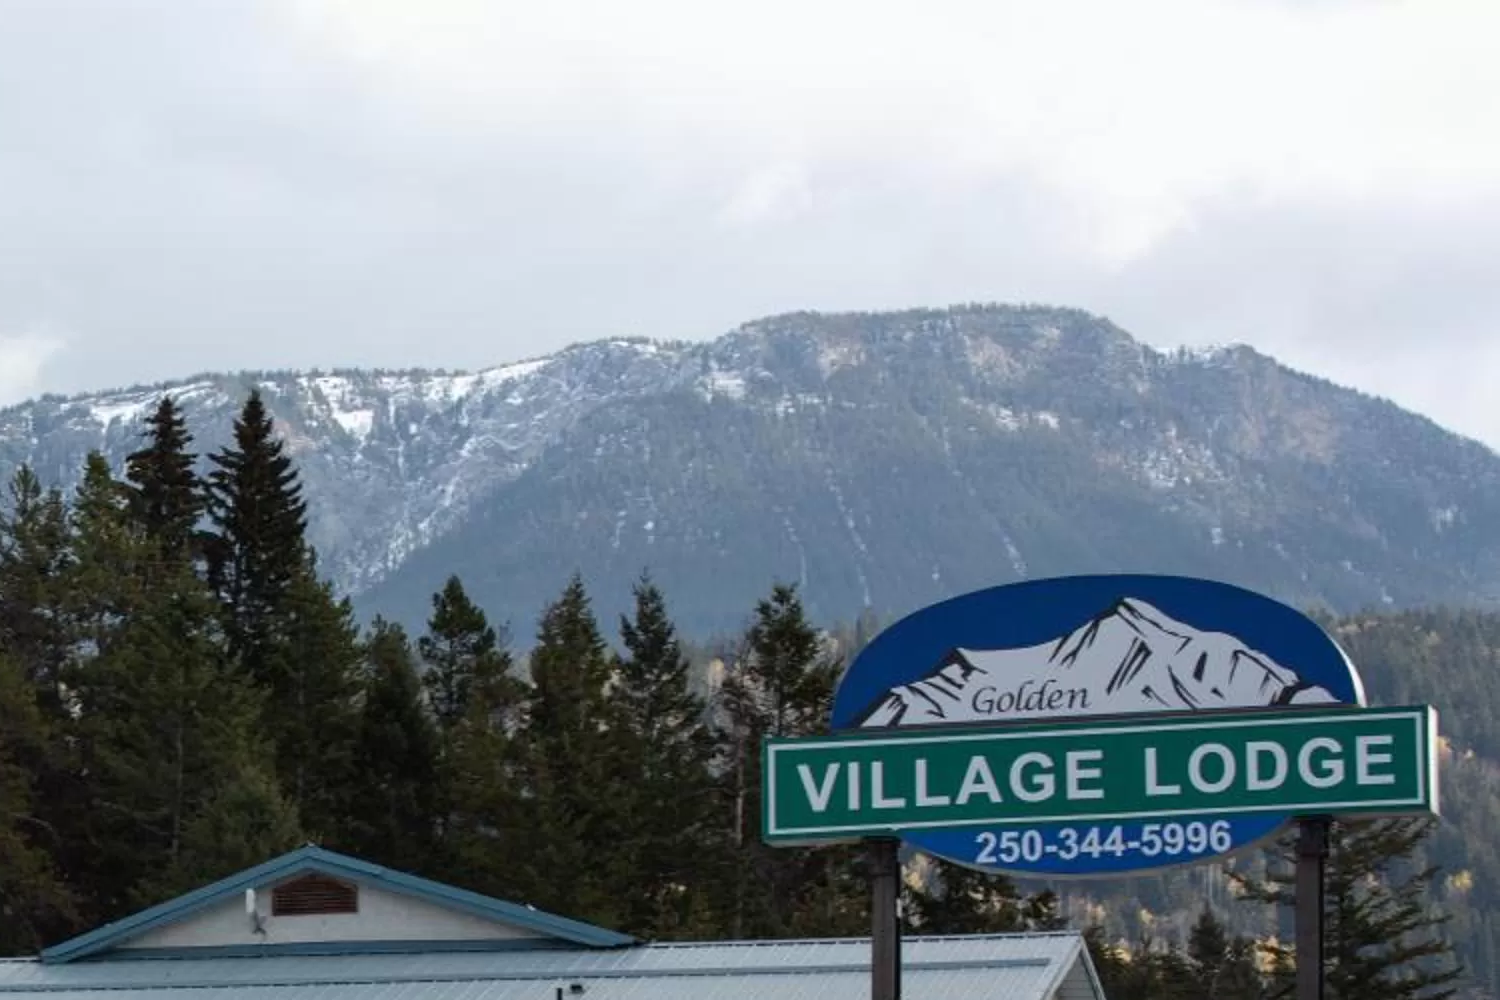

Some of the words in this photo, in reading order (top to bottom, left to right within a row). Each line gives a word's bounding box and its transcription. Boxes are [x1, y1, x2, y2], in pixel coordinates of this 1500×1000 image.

[972, 679, 1092, 714] Golden
[797, 749, 1104, 812] VILLAGE
[1145, 735, 1396, 796] LODGE
[975, 820, 1232, 864] 250-344-5996
